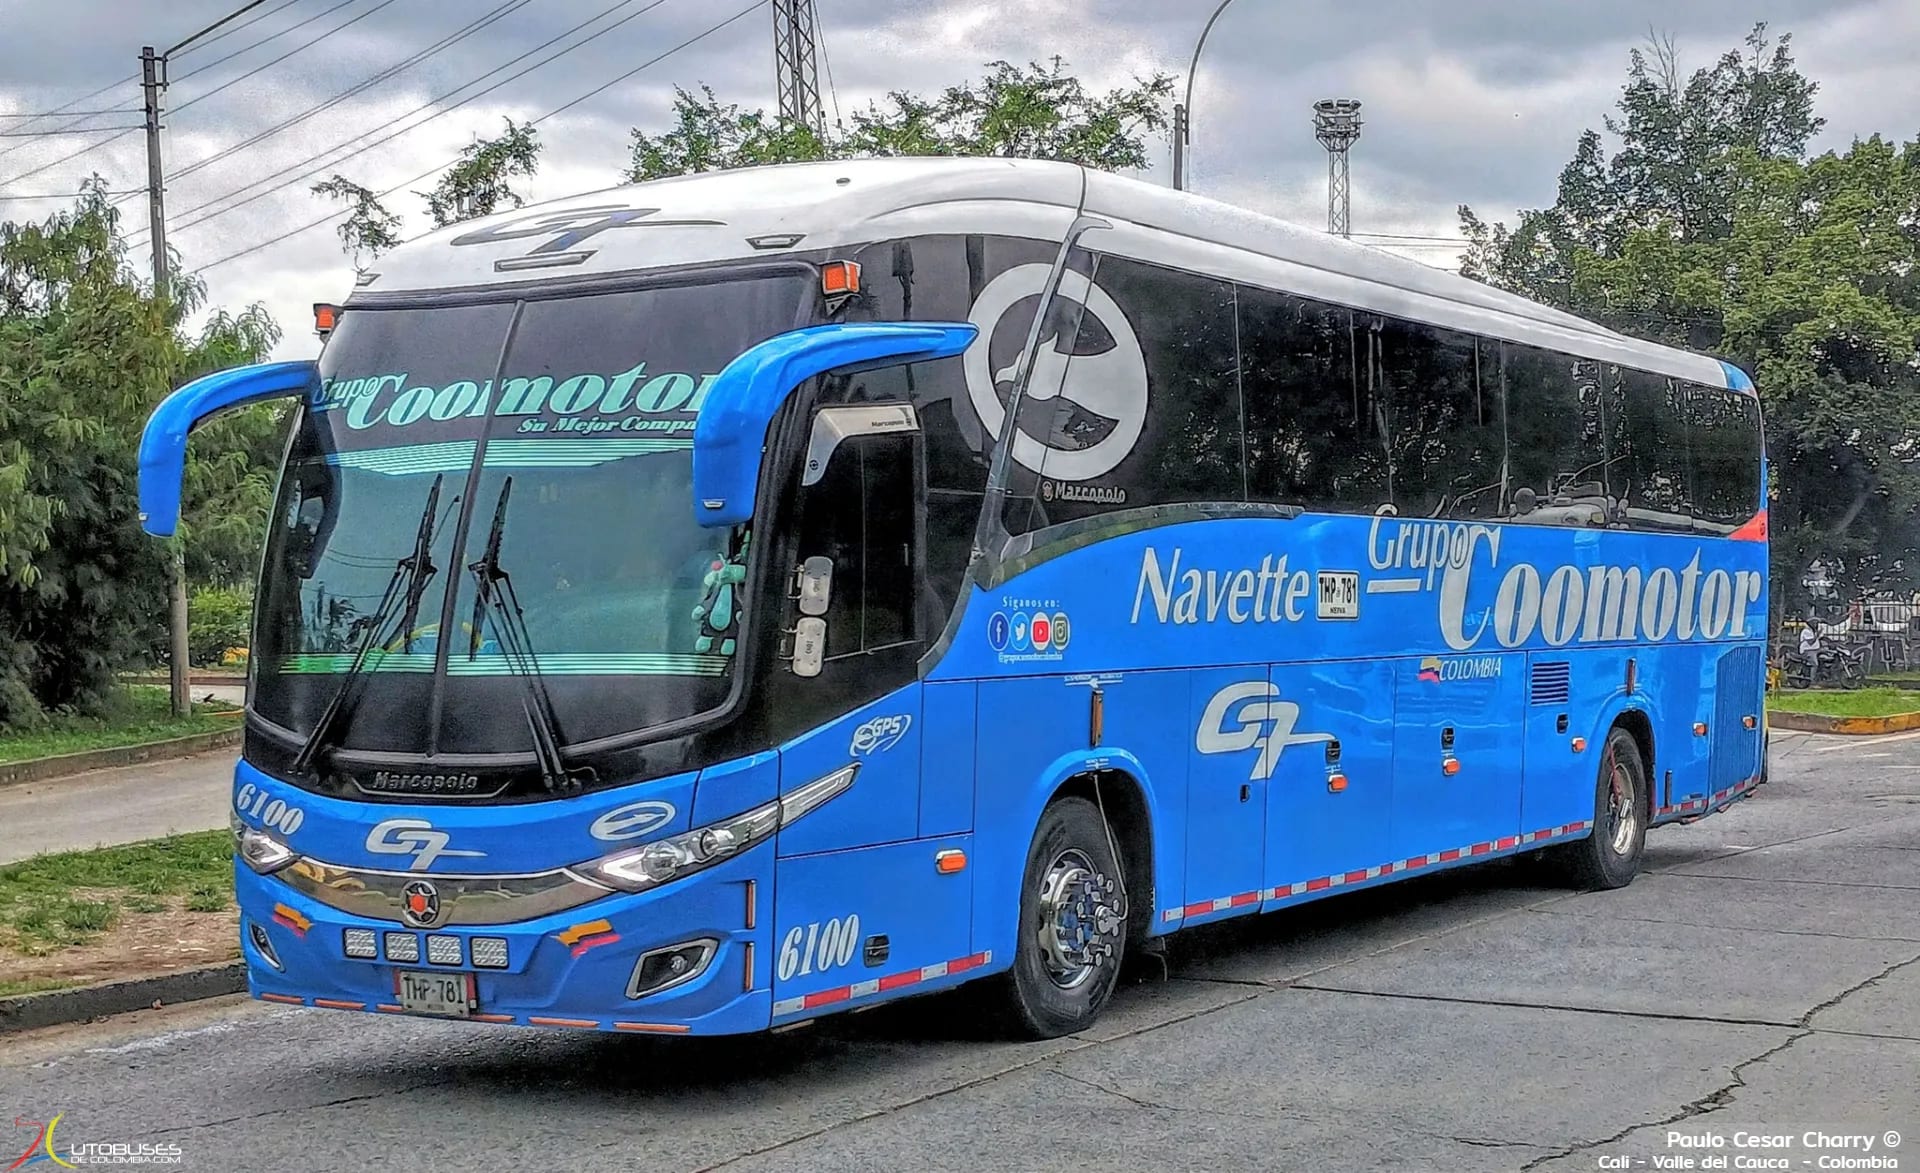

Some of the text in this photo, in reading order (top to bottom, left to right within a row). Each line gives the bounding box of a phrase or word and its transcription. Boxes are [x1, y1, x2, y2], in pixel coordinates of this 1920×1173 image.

[517, 416, 697, 435] Su Mejor Compa
[1055, 482, 1126, 503] Marcopolo
[1130, 547, 1310, 624] Navette
[1368, 504, 1762, 650] Grupo Coomotor
[1440, 657, 1502, 680] COLOMBIA
[873, 715, 903, 737] GPS
[373, 771, 478, 792] Marcopolo
[237, 783, 304, 835] 6100
[778, 914, 859, 981] 6100
